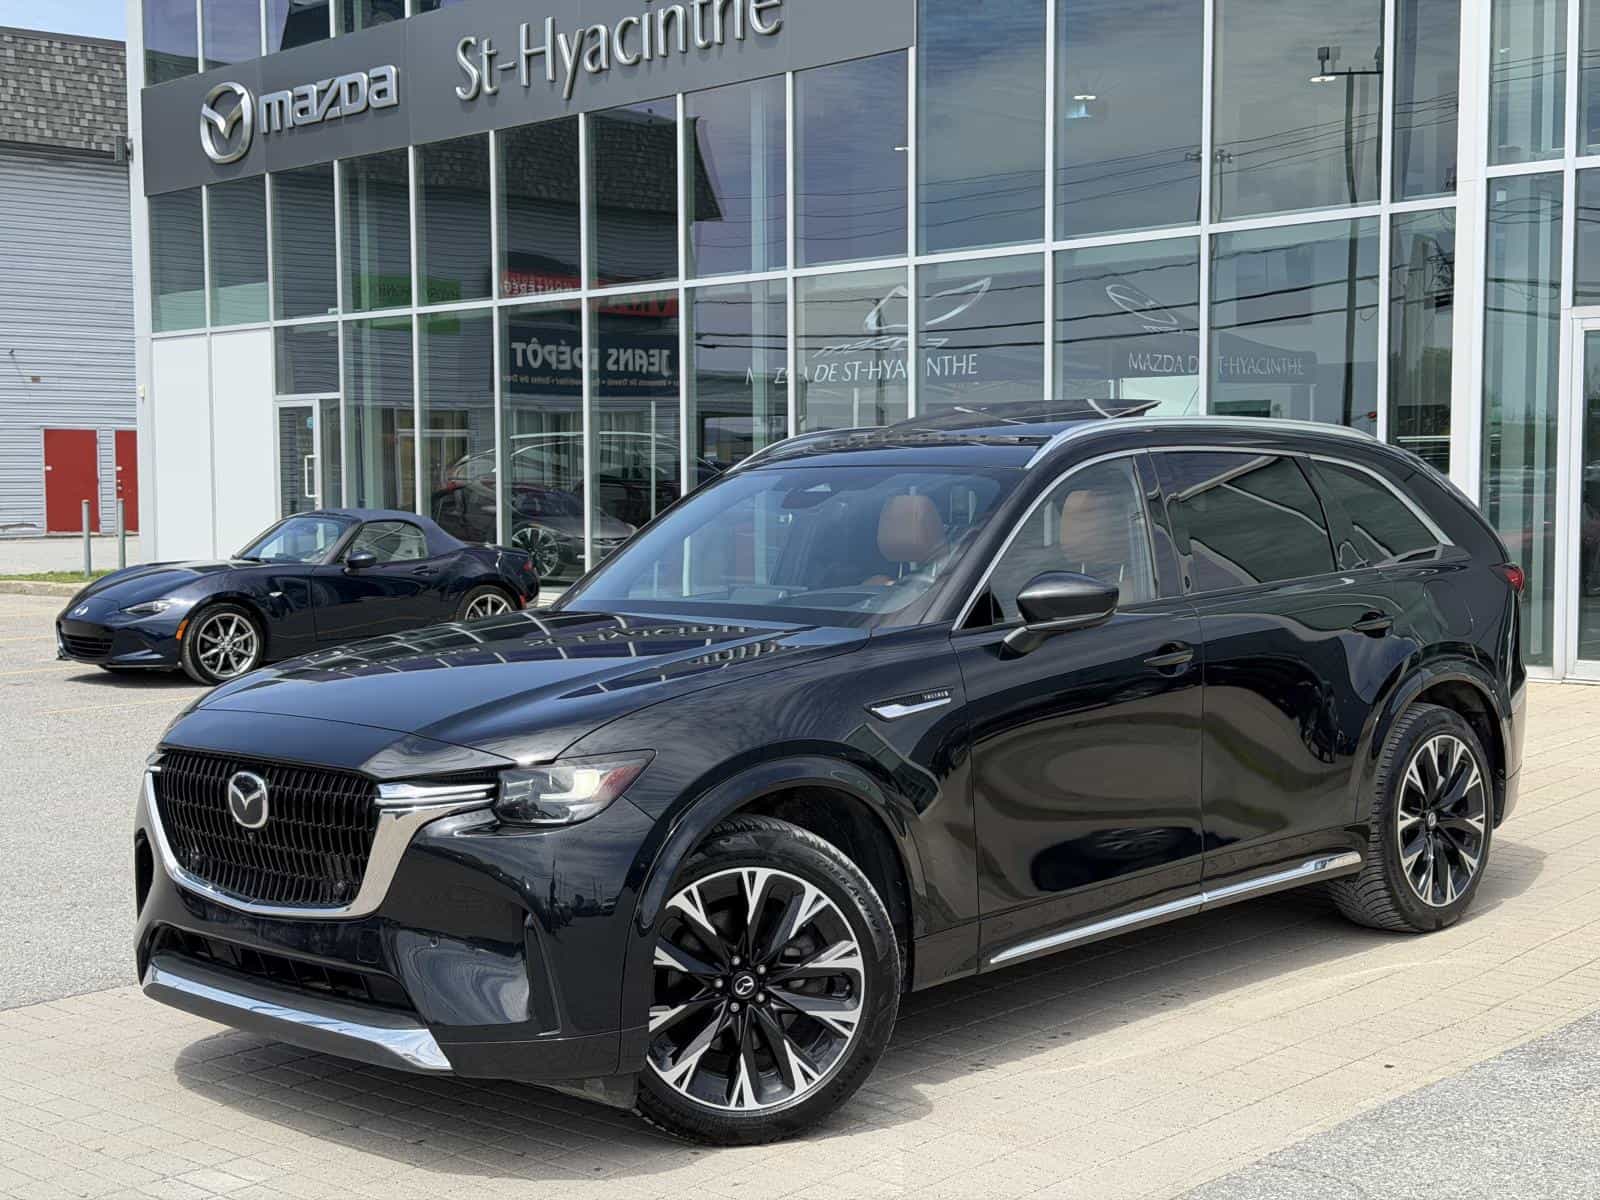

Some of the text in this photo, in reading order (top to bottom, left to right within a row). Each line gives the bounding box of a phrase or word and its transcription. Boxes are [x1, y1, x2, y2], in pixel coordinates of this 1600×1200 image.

[455, 0, 784, 100] St-Hyacinthe
[813, 363, 838, 384] DE
[843, 353, 978, 384] ST-HYANTHE
[1128, 351, 1185, 374] MAZDA
[1216, 355, 1305, 376] T-HYACINTHE
